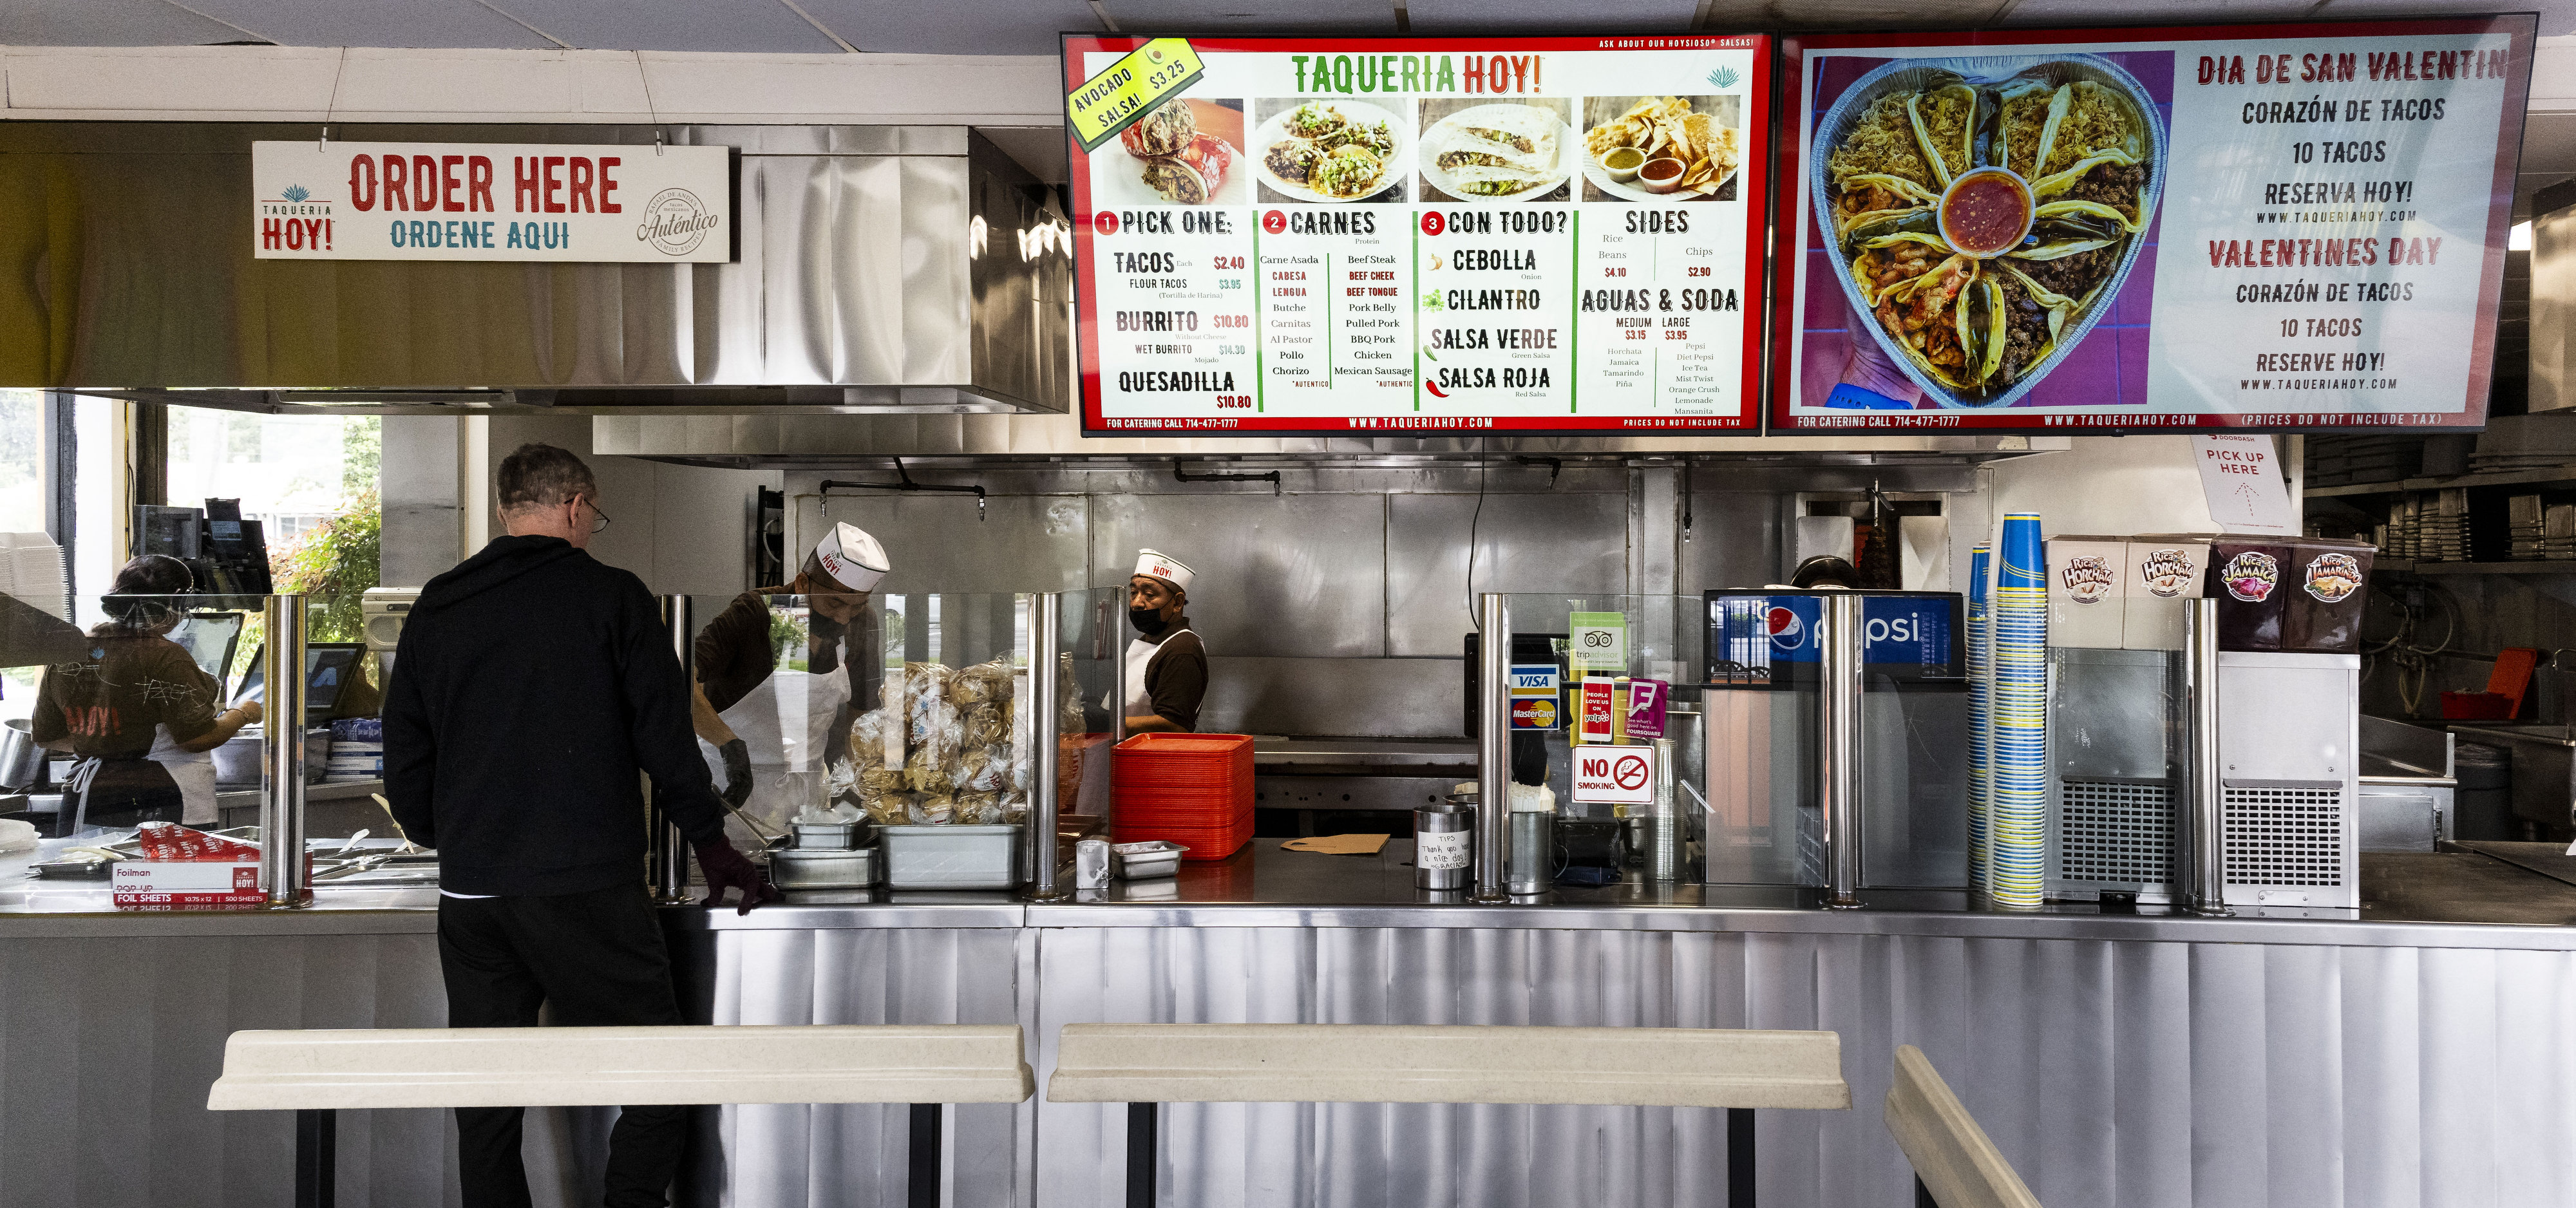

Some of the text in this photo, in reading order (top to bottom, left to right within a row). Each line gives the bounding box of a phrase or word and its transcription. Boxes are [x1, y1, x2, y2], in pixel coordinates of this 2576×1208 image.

[2198, 48, 2509, 85] DIA DE SAN VALENTIN
[1149, 59, 1186, 90] $3.25
[1292, 55, 1544, 95] TAQUERIA HOY!
[1074, 68, 1132, 113] AVOCADO
[1097, 92, 1142, 128] SALSA!
[2242, 95, 2446, 124] CORAZÓN DE TACOS
[2293, 140, 2387, 164] 10 TACOS
[348, 153, 622, 214] ORDER HERE
[2264, 181, 2413, 205] RESERVA HOY!
[649, 194, 667, 214] RAFAEL
[677, 192, 697, 207] ANDA'S
[263, 205, 330, 215] TAQUERIA
[637, 209, 717, 241] Auténtico
[1122, 211, 1175, 234] PICK
[1290, 211, 1376, 235] CARNES
[1448, 211, 1568, 234] CON TODO?
[1625, 210, 1689, 234] SIDES
[261, 218, 333, 251] HOY!
[390, 220, 570, 250] ORDENE AQUI
[1602, 234, 1623, 243] Rice
[656, 232, 702, 252] FAMILY RECIPES
[1598, 250, 1627, 259] Beans
[1685, 247, 1713, 257] Chips
[2209, 236, 2443, 268] VALENTINES DAY
[1113, 252, 1244, 273] TACOS $2.40
[1260, 256, 1319, 264] Carne Asada
[1348, 255, 1396, 263] Beef Steak
[1453, 249, 1536, 270] CEBOLLA
[1272, 271, 1306, 281] CABESA
[1349, 271, 1395, 281] BEEF CHEEK
[1130, 278, 1188, 288] FLOUR TACOS
[1273, 287, 1307, 297] LENGUA
[1347, 287, 1398, 296] BEEF TONGUE
[2235, 279, 2414, 303] CORAZÓN DE TACOS
[1448, 288, 1541, 310] CILANTRO
[1582, 288, 1739, 312] AGUAS SODA
[1349, 303, 1370, 312] Pork
[1116, 310, 1198, 332] BURRITO
[1271, 319, 1311, 328] Carnitas
[1345, 319, 1400, 328] Pulled Pork
[1616, 317, 1690, 327] MEDIUM LARGE
[2280, 317, 2363, 337] 10 TACOS
[1374, 335, 1396, 343] Pork
[1431, 328, 1557, 350] SALSA VERDE
[1135, 344, 1193, 354] WET BURRITO
[1280, 351, 1304, 359] Pollo
[1354, 351, 1392, 359] Chicken
[2256, 353, 2385, 372] RESERVE HOY!
[1273, 366, 1309, 375] Chorizo
[1334, 366, 1372, 375] Mexican
[1119, 371, 1235, 393] QUESADILLA
[1439, 367, 1550, 388] SALSA ROJA
[2240, 378, 2397, 390] WWW.TAQUERIAHOY.COM
[1217, 395, 1251, 409] $10.80
[1107, 419, 1238, 428] FOR CATERING CALL 714-477-1777
[1349, 417, 1493, 428] WWW.TAQUERIAHOY.COM
[1819, 416, 1960, 428] CATERING 714-477-1777
[2044, 415, 2196, 426] WWW.TAQUERIAHOY.COM
[2206, 449, 2264, 462] PICK UP
[2220, 463, 2260, 475] HERE
[2071, 558, 2094, 569] Rica
[2150, 551, 2174, 563] Rica
[2238, 554, 2261, 566] Rica
[2319, 556, 2341, 566] Rico
[822, 553, 840, 576] HOY!
[1153, 565, 1171, 579] HOY!
[2142, 561, 2194, 582] HORCHATA
[2224, 564, 2277, 583] JAMAICA
[2308, 563, 2362, 583] TAMARINDO
[2062, 568, 2113, 589] HORCHATA
[1577, 650, 1618, 659] tripadvisor
[1519, 675, 1549, 687] VISA
[1513, 709, 1555, 718] MasterCard
[1584, 713, 1602, 722] yelp
[65, 706, 121, 736] HOY!
[1582, 759, 1609, 777] NO
[1578, 782, 1615, 790] SMOKING
[1421, 845, 1443, 853] Thank
[236, 879, 254, 888] HOY!
